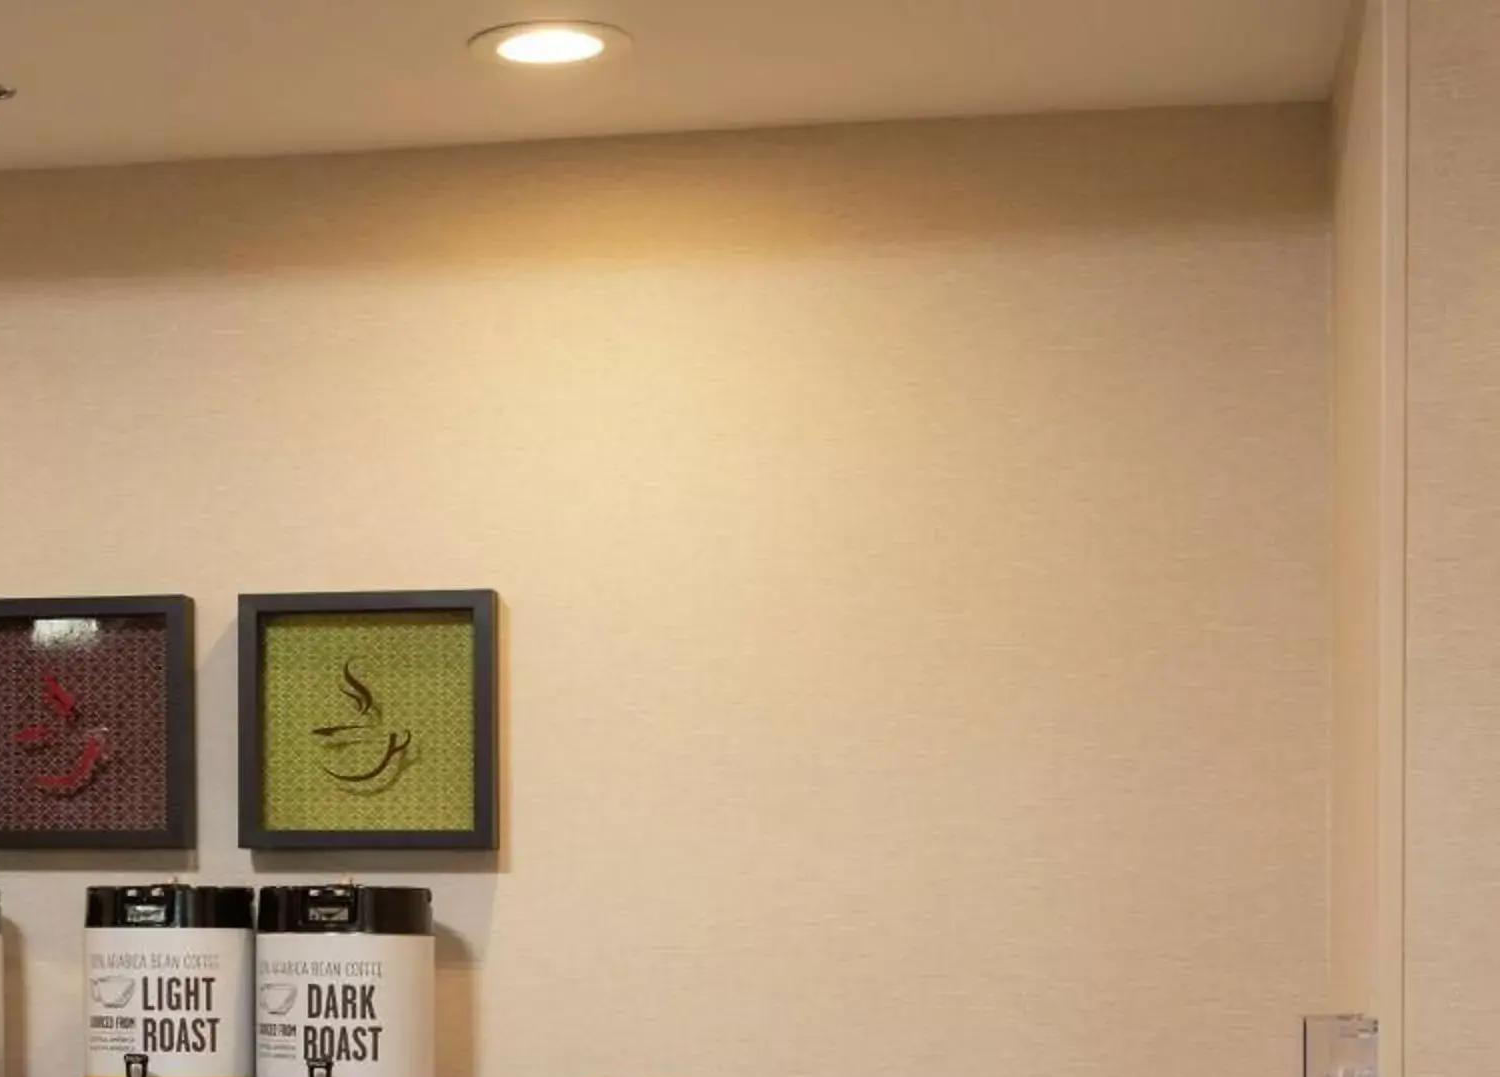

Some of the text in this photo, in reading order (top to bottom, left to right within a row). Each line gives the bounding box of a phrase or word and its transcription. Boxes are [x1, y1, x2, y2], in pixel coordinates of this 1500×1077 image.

[142, 976, 216, 1011] LIGHT
[307, 983, 376, 1019] DARK
[142, 1017, 221, 1053] ROAST
[303, 1025, 382, 1061] ROAST
